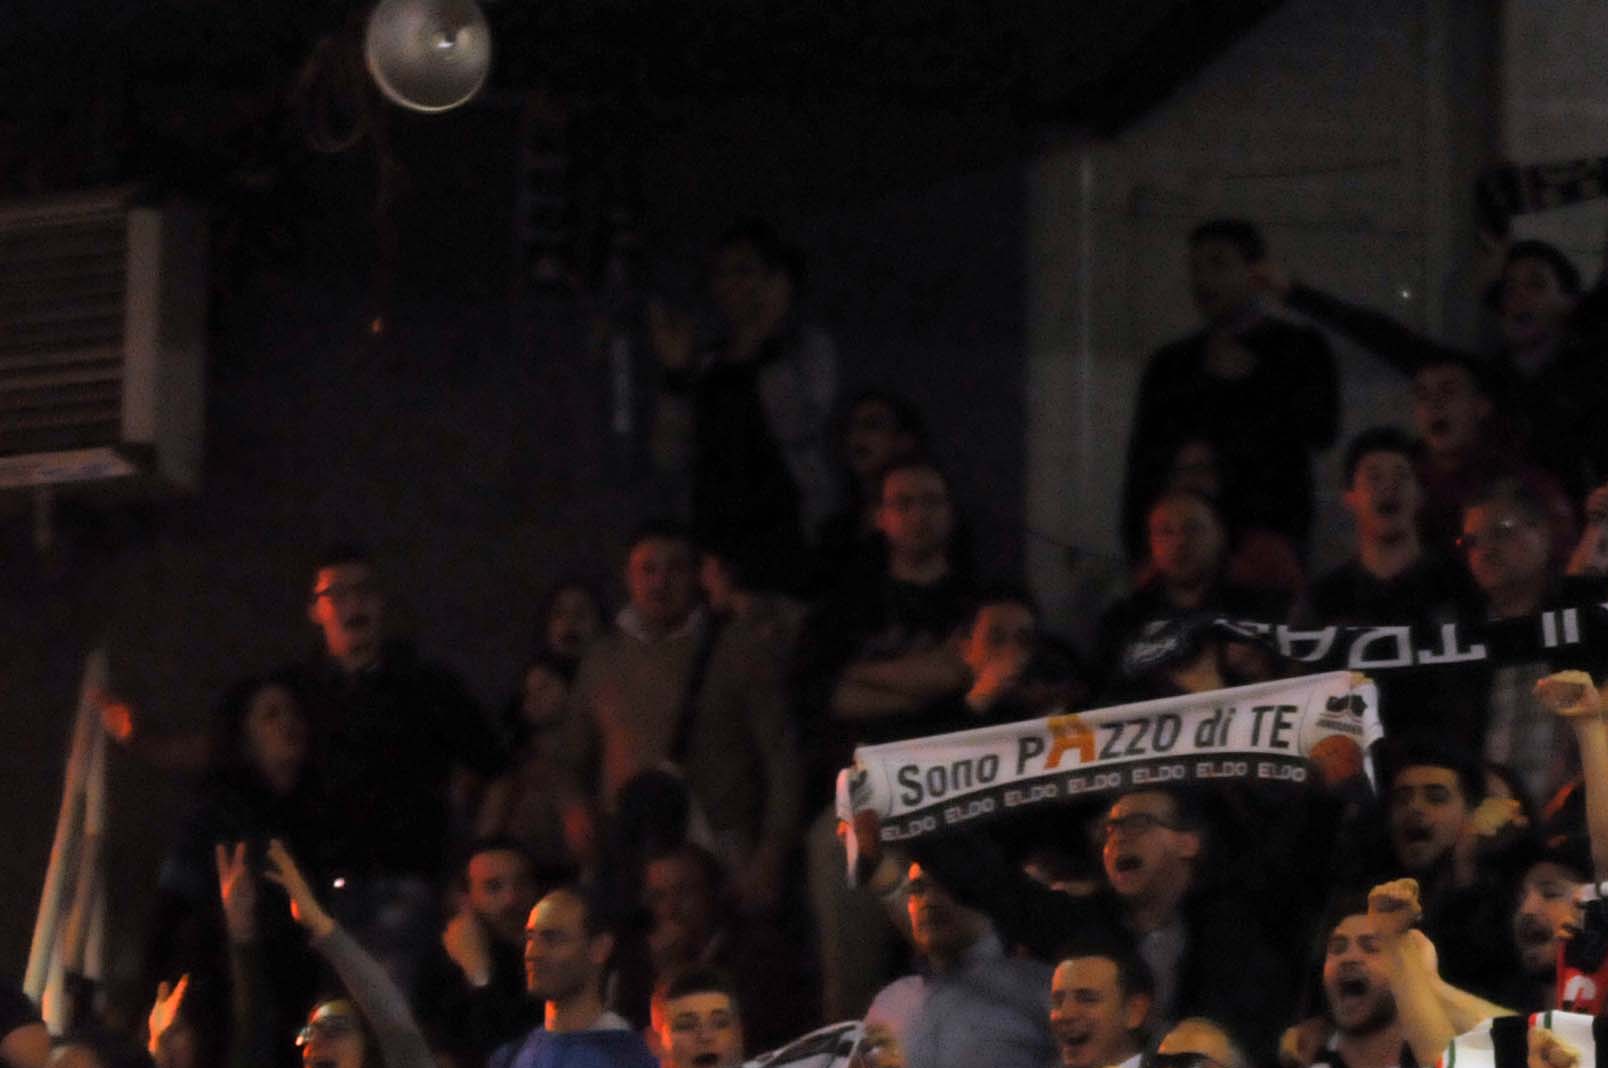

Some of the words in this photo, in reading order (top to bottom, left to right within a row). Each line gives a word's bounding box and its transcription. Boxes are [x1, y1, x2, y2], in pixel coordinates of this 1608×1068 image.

[897, 753, 999, 806] Sono
[1015, 712, 1182, 776] PAZZO
[1195, 706, 1237, 748] di
[1250, 703, 1299, 749] TE
